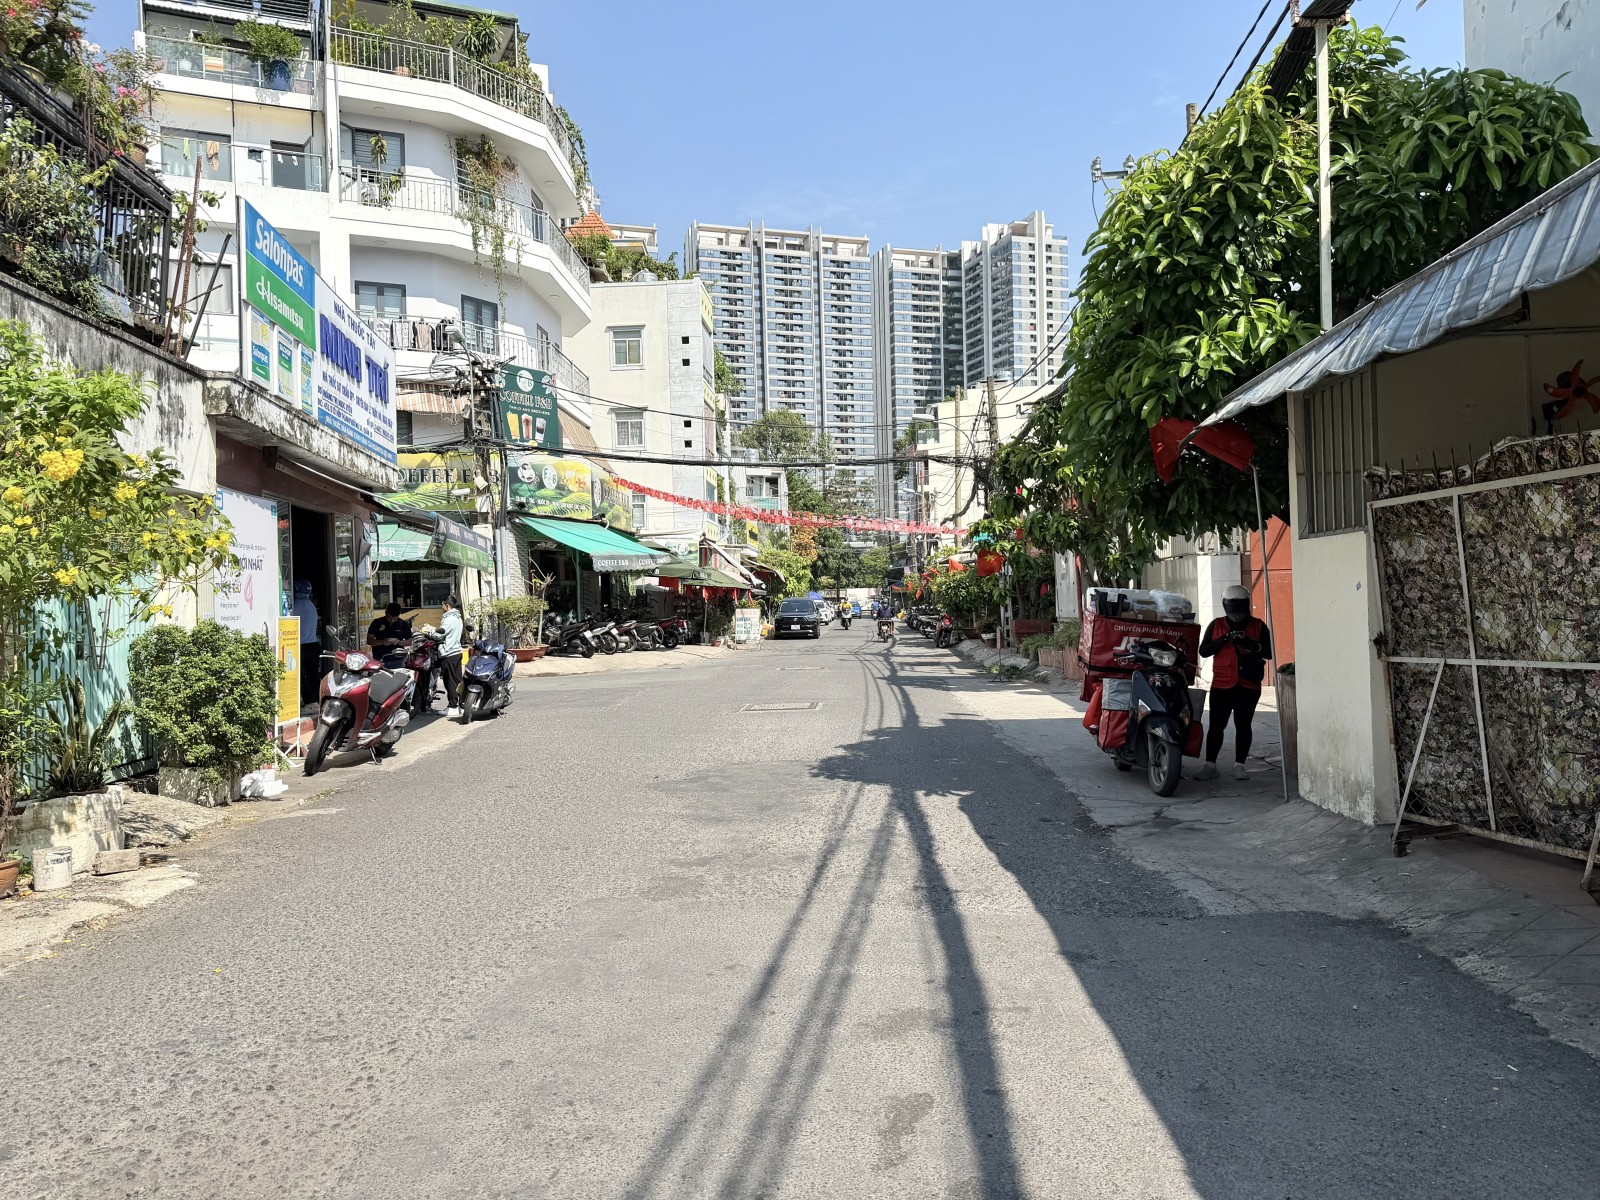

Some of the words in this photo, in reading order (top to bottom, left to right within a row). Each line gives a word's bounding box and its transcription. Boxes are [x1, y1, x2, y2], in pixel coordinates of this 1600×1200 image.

[255, 218, 304, 288] Salonpas
[256, 275, 304, 331] Hisamitsu
[333, 300, 345, 322] NHÀ
[347, 314, 365, 340] THUỐC
[366, 332, 376, 351] TÂY
[319, 313, 362, 384] MINH
[365, 354, 389, 405] TRÍ
[500, 389, 534, 408] COFFEE
[397, 467, 455, 484] OFFEE
[248, 555, 264, 571] NHẤT
